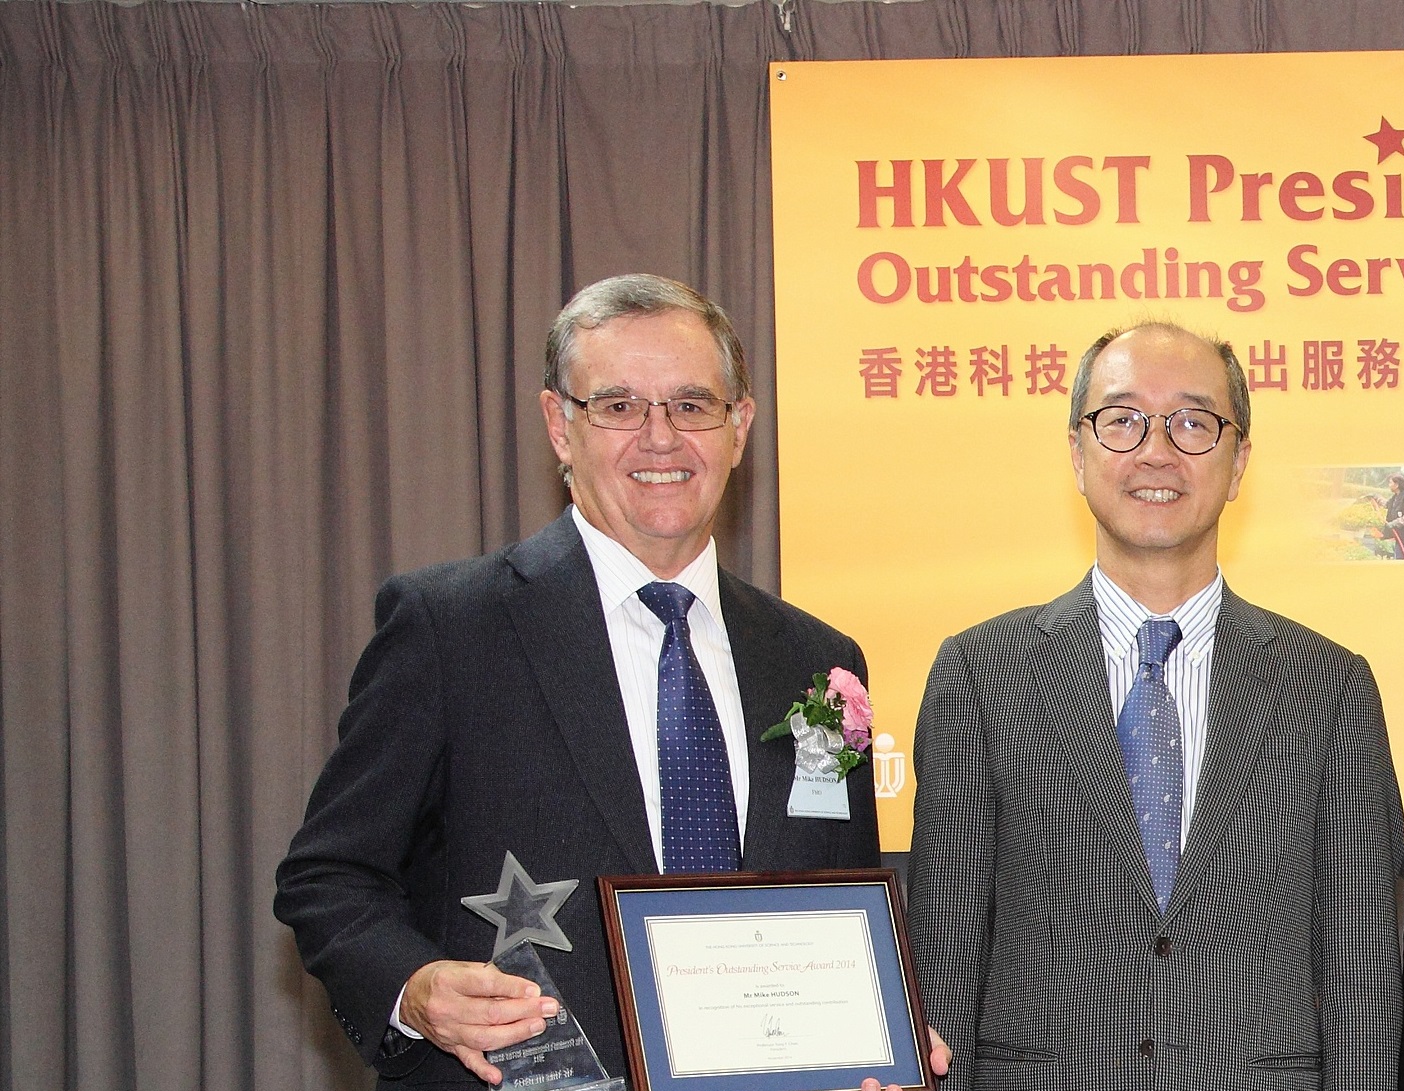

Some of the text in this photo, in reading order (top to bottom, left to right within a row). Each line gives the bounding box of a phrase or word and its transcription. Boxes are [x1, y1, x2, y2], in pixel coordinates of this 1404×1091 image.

[855, 155, 1151, 228] HKUST
[857, 247, 1266, 313] Outstanding
[666, 960, 856, 977] President's Outstanding Service Award 2014
